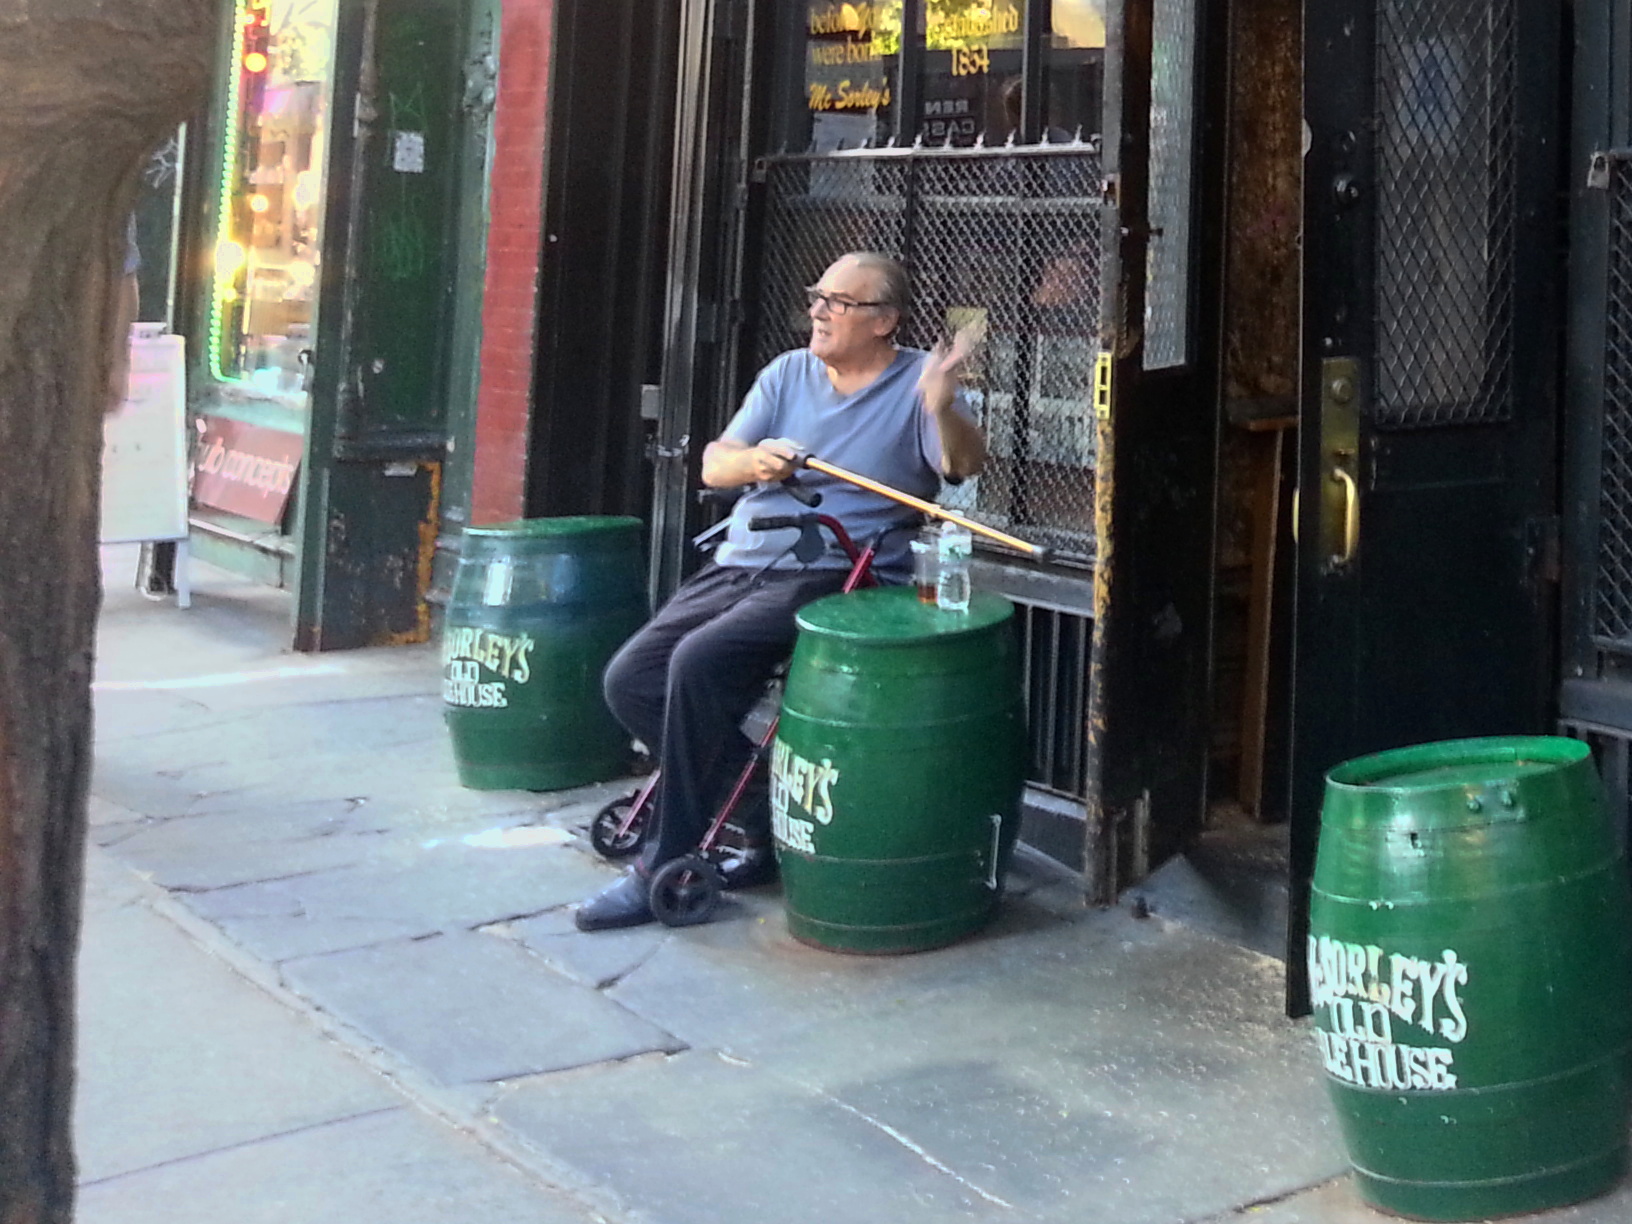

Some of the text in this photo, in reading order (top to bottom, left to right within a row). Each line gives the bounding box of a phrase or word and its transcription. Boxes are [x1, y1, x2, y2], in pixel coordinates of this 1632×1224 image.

[952, 44, 990, 76] 1854
[838, 75, 891, 116] Sorley's
[1331, 997, 1392, 1043] OLD
[1350, 1039, 1458, 1091] HOUSE
